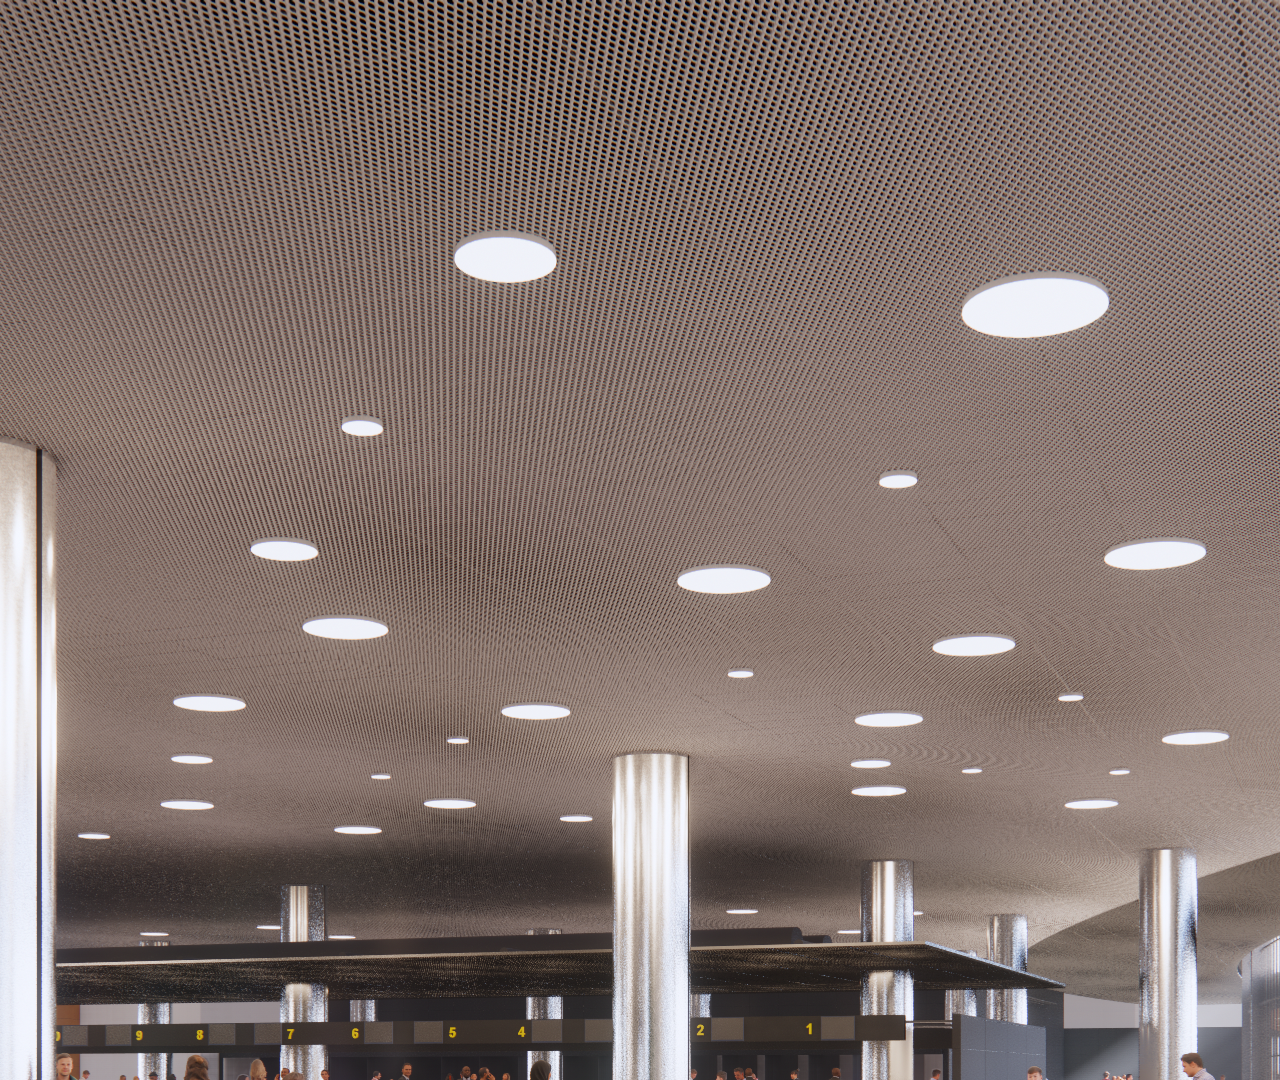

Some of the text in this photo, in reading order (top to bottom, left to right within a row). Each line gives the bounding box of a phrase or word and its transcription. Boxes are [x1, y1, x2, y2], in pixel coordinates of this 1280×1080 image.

[286, 1028, 295, 1040] 7
[351, 1027, 359, 1039] 6
[448, 1026, 457, 1038] 5
[517, 1026, 526, 1038] 4
[696, 1024, 705, 1036] 2
[805, 1022, 813, 1035] 1
[135, 1030, 143, 1041] 9
[196, 1029, 204, 1041] 8
